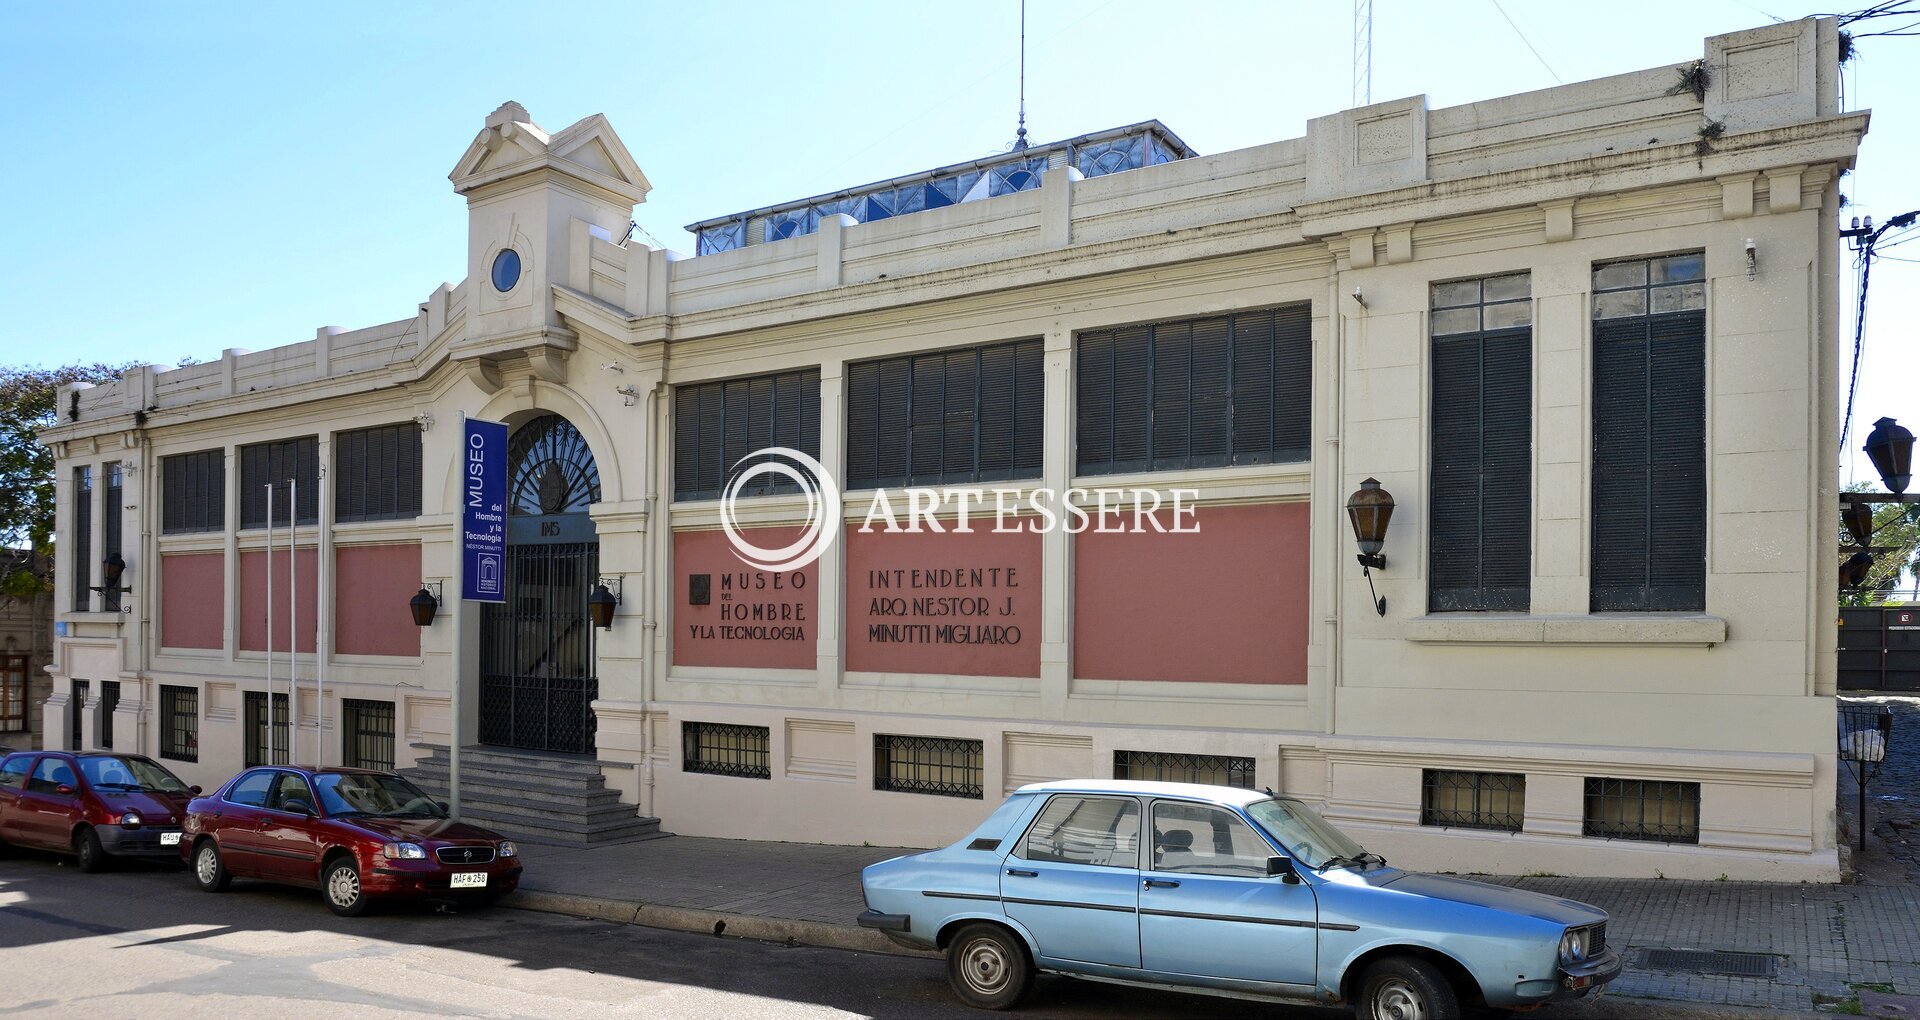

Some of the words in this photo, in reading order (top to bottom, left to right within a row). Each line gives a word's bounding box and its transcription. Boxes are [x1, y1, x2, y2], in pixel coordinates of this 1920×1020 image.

[469, 434, 484, 507] MUSEO
[475, 512, 502, 522] Hombre
[489, 525, 495, 533] y
[721, 571, 806, 590] MUSEO
[869, 568, 1018, 588] INTENDENTE
[721, 603, 806, 621] HOMBRE
[912, 597, 990, 616] NESTOR
[1000, 597, 1016, 616] J.
[690, 625, 698, 639] Y
[700, 626, 715, 639] LA
[719, 625, 805, 640] TECNOLOGIA
[869, 624, 931, 643] MINUTTI
[936, 624, 1022, 645] MIGLIARO
